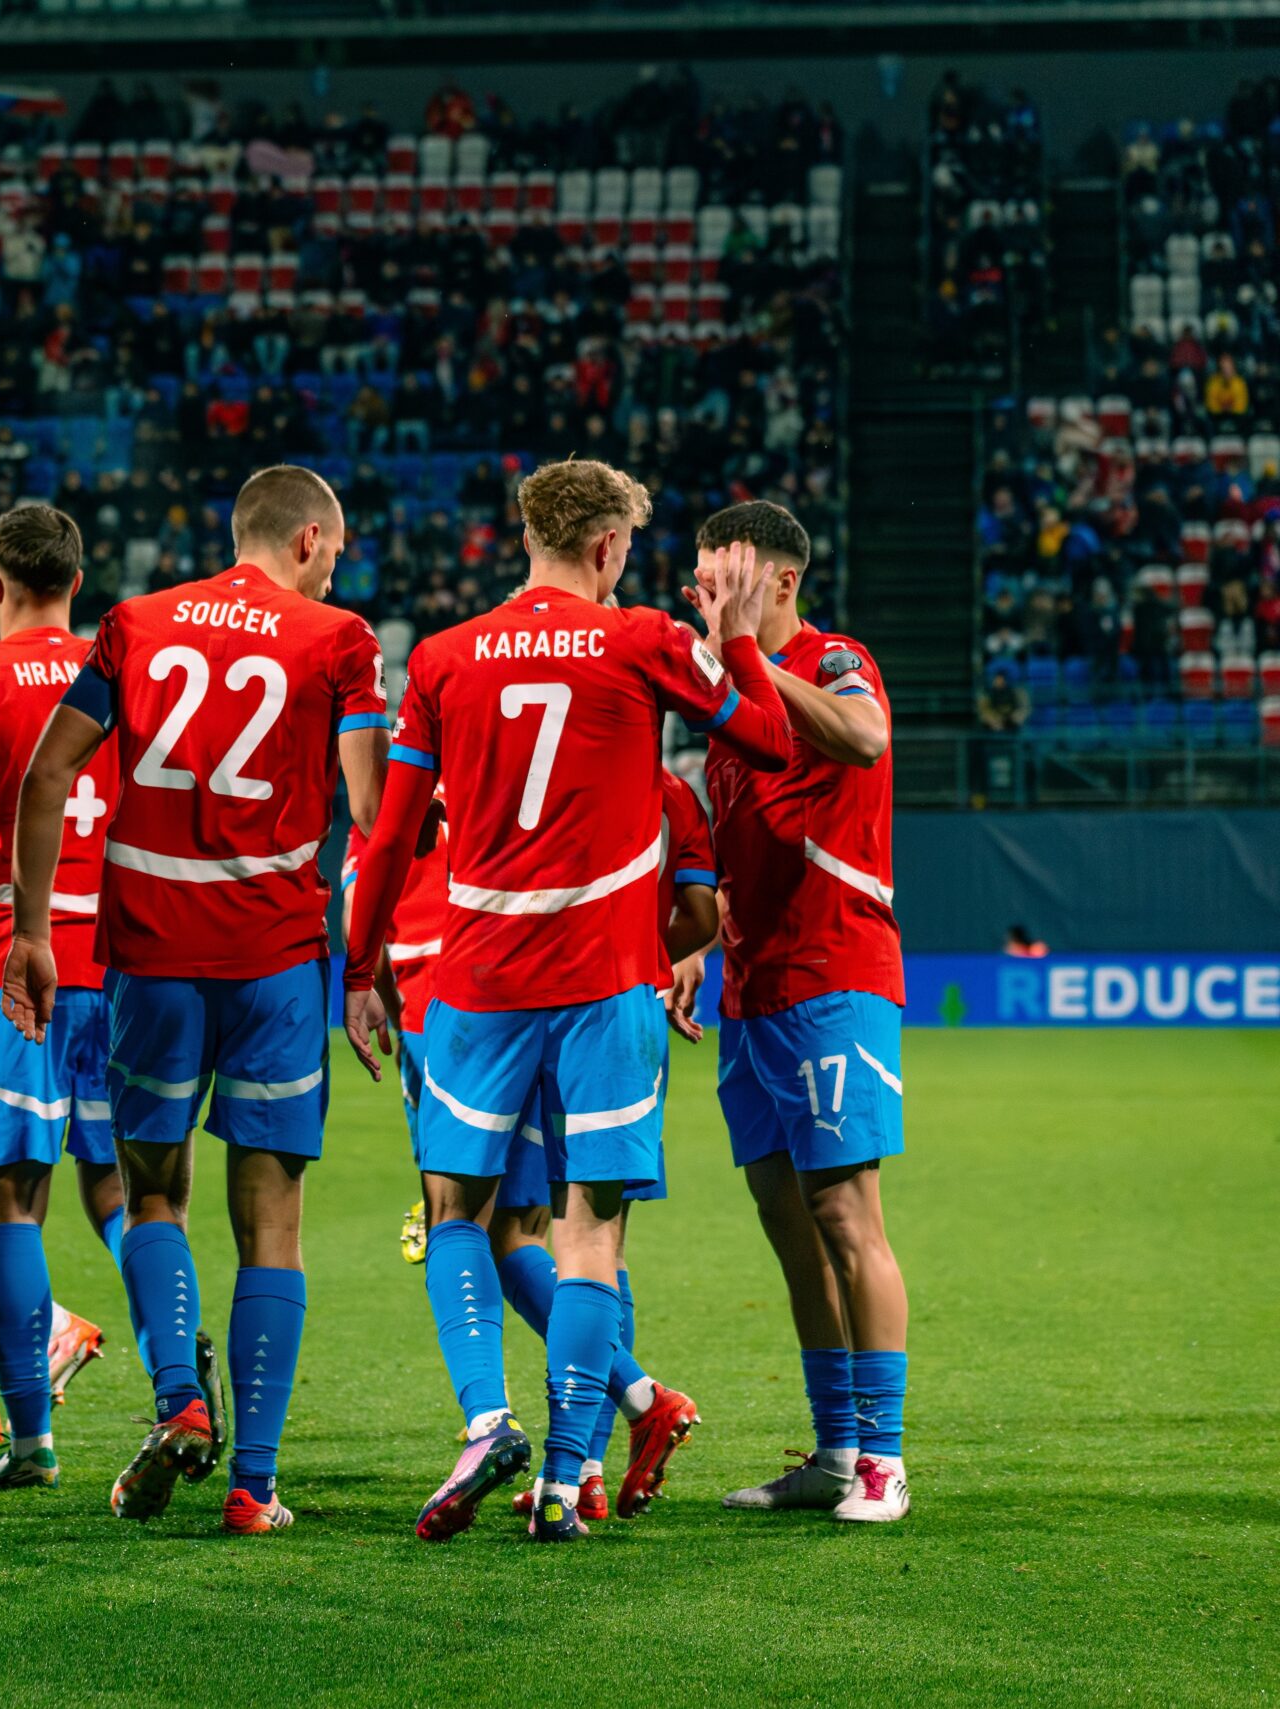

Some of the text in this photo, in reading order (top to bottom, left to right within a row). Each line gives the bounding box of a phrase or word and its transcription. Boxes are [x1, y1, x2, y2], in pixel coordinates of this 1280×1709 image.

[172, 598, 282, 638] SOUČEK
[474, 628, 606, 661] KARABEC
[132, 645, 288, 801] 22
[500, 682, 572, 831] 7
[998, 966, 1280, 1019] REDUCE
[797, 1054, 847, 1116] 17
